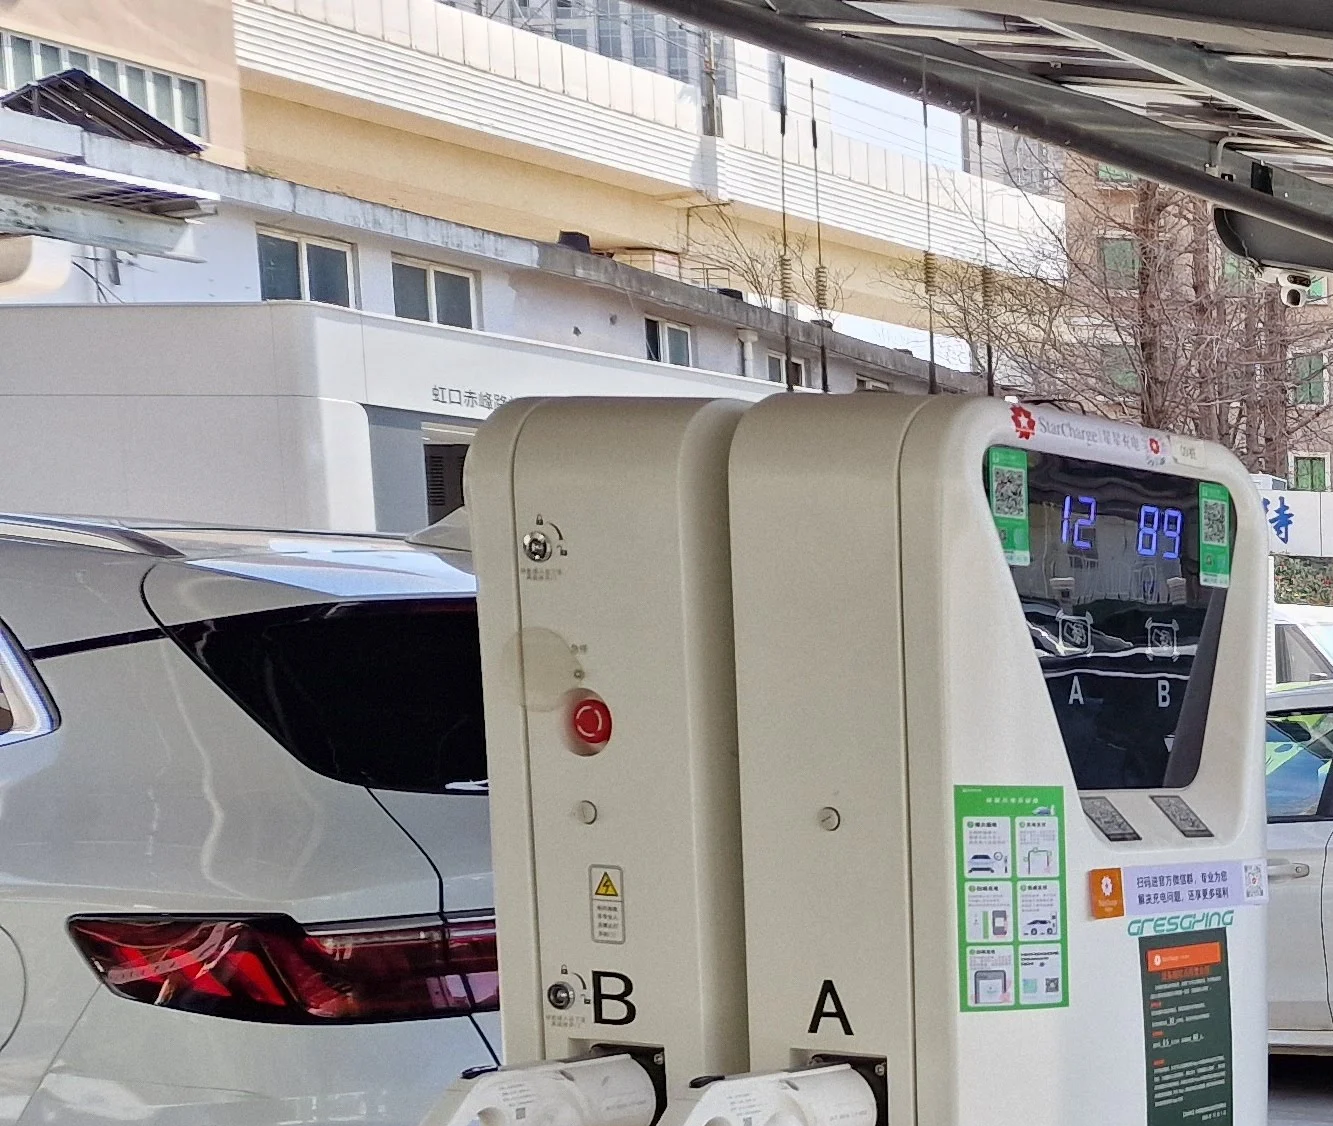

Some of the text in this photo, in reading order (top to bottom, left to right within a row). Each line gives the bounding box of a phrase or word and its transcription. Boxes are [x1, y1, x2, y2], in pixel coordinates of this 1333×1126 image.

[432, 385, 513, 409] 虹口赤峰路
[1038, 416, 1098, 445] StarCharge
[1061, 495, 1183, 560] 12 89
[1068, 675, 1171, 708] A B
[591, 970, 637, 1026] B
[808, 979, 854, 1036] A
